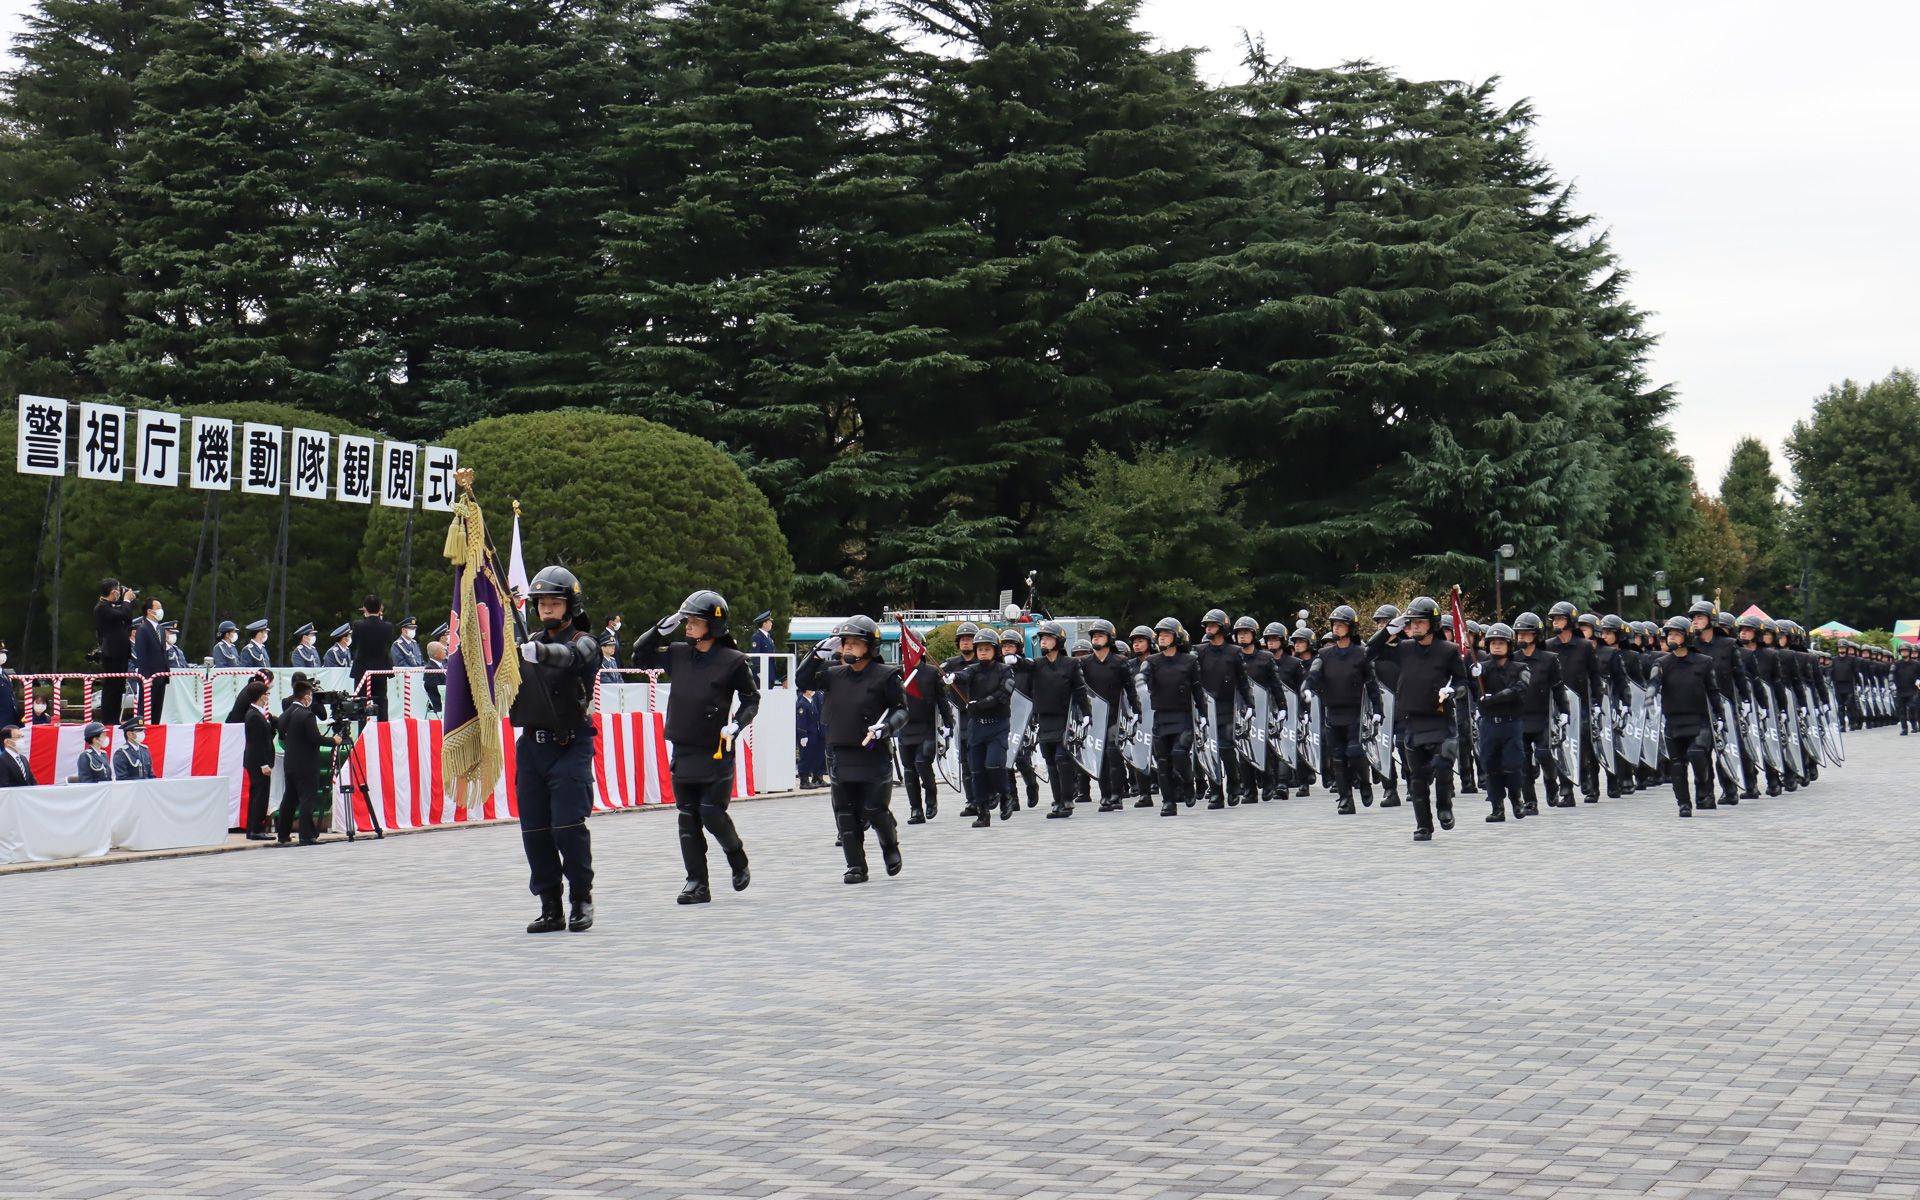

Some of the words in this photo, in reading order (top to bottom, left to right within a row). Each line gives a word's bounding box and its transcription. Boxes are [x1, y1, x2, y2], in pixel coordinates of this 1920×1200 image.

[26, 404, 455, 505] 警視庁機動隊観閲式
[715, 606, 722, 617] 4
